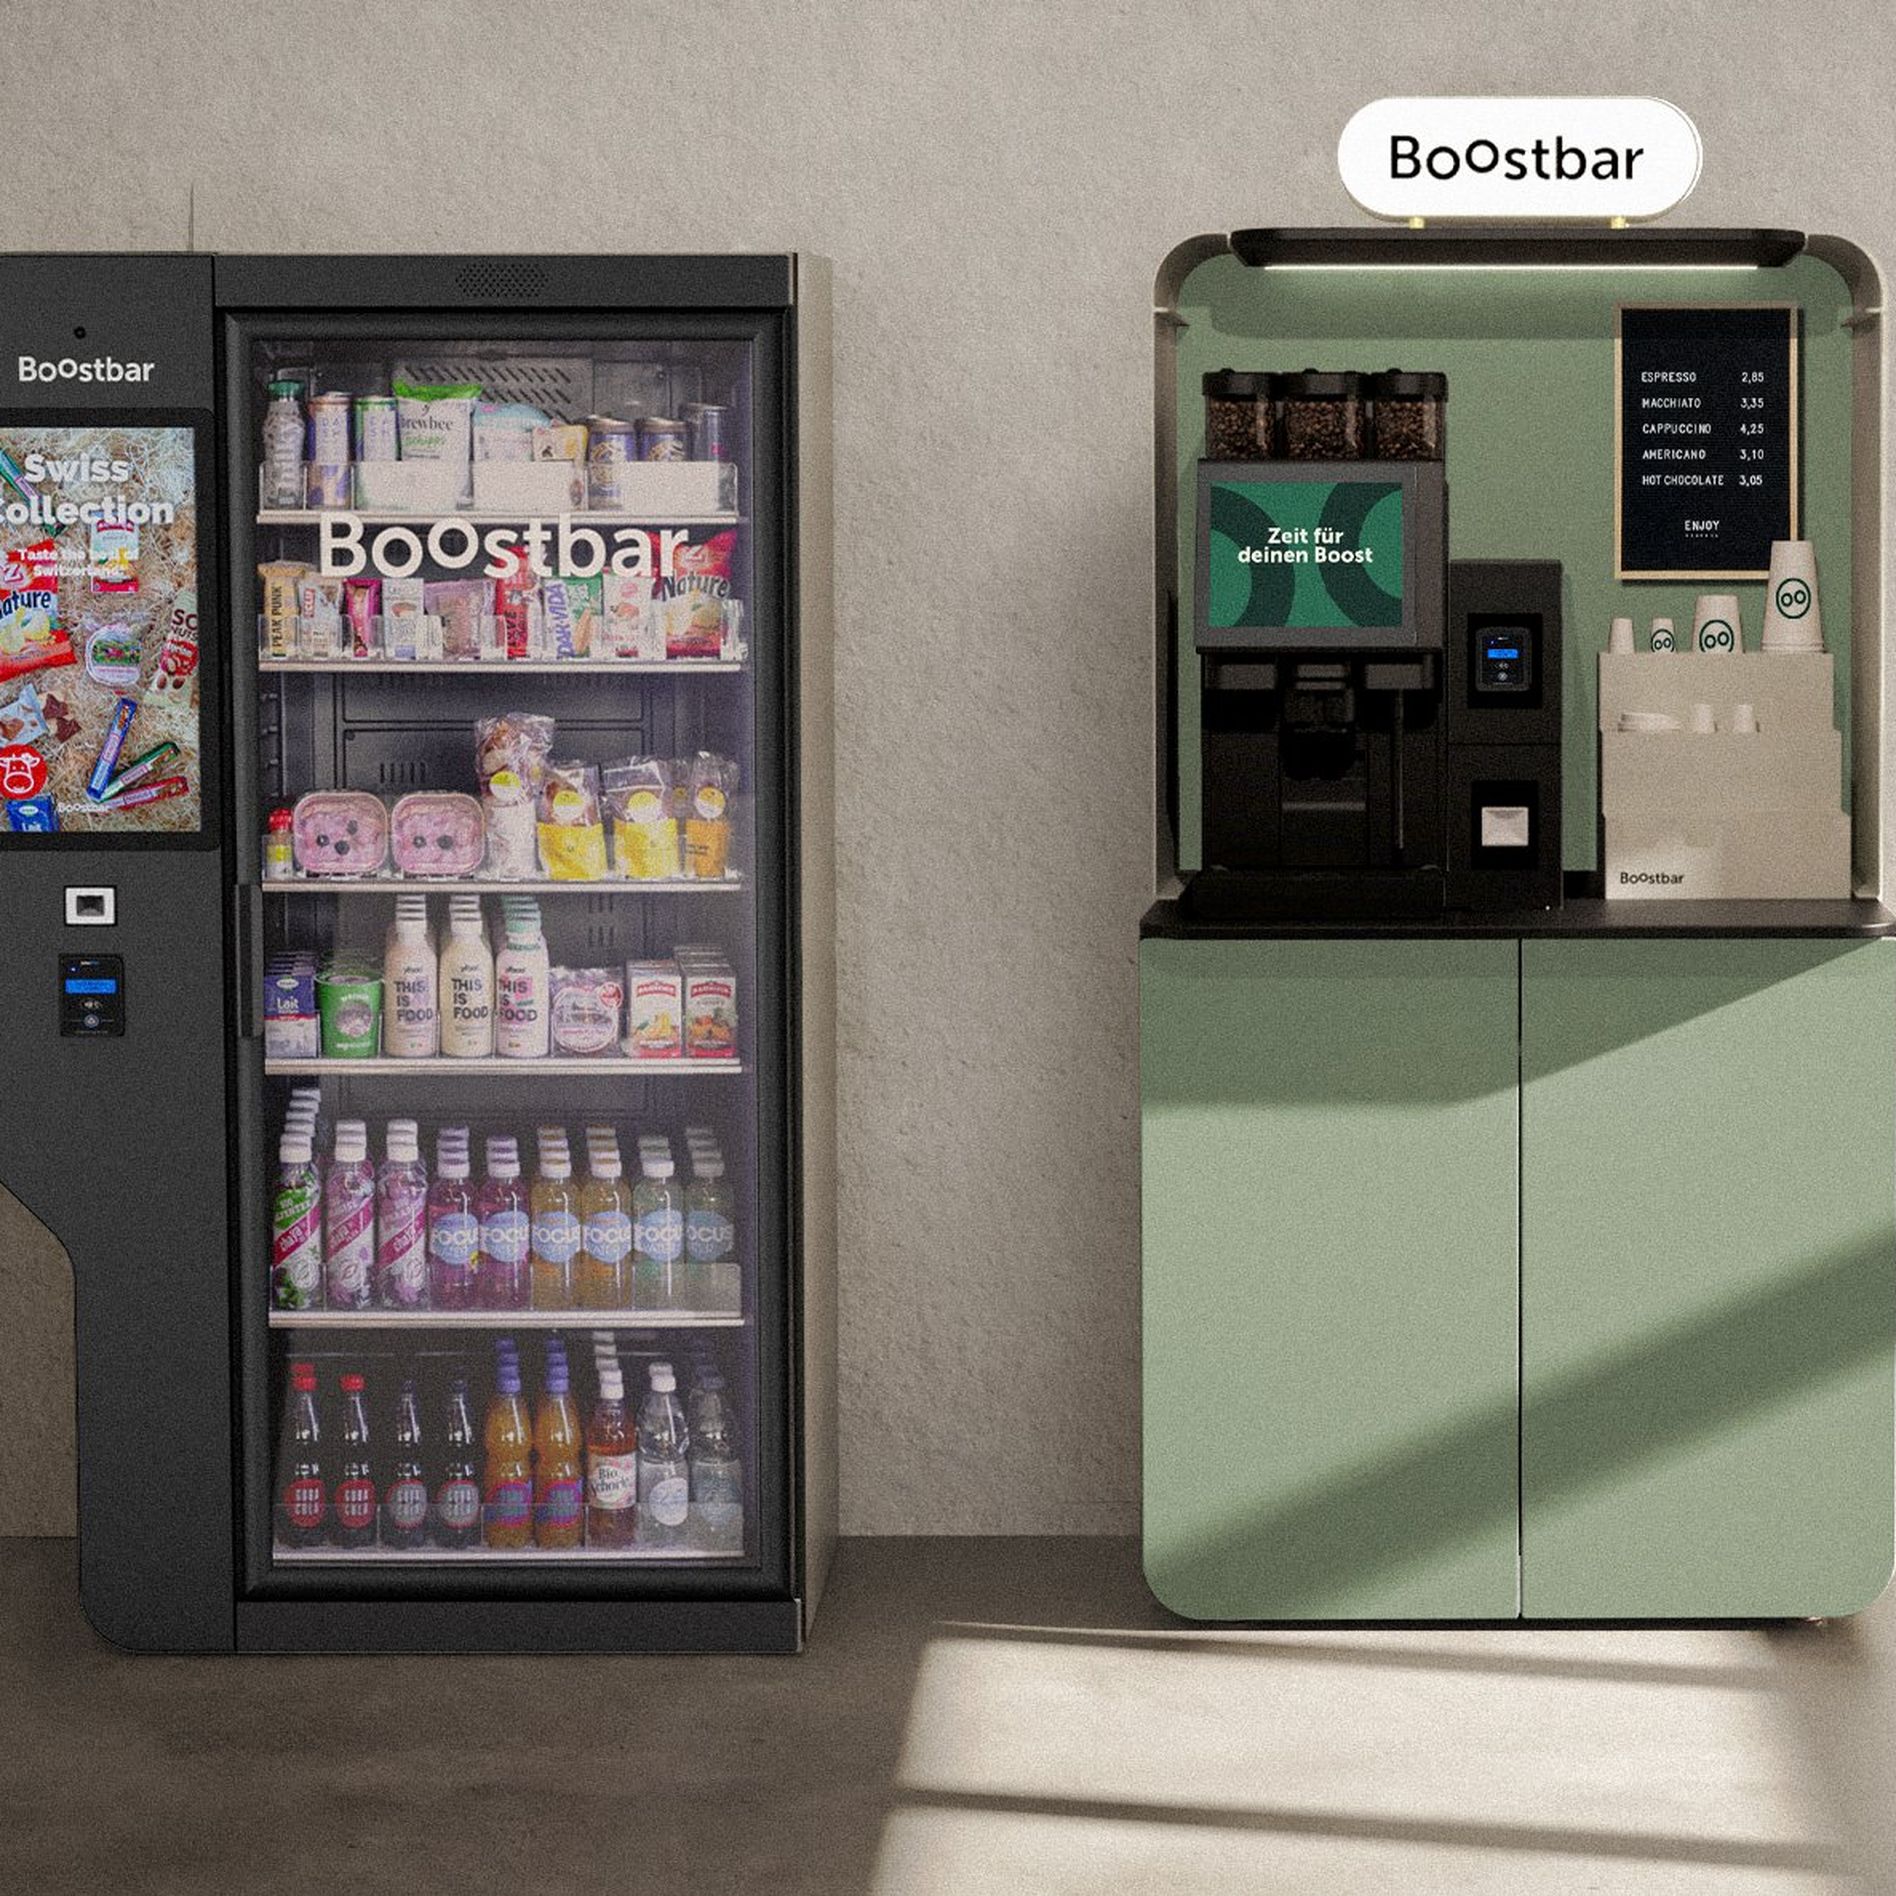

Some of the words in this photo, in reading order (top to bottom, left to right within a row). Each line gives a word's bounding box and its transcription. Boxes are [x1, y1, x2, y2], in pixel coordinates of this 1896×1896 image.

[1390, 135, 1644, 181] Boostbar
[18, 356, 155, 383] Boostbar
[1641, 371, 1697, 383] ESPRESSO
[1741, 371, 1765, 384] 2,85
[1641, 397, 1702, 409] MACCHIATO
[1740, 397, 1764, 410] 3,35
[1642, 422, 1712, 435] CAPPUCCINO
[1740, 423, 1765, 436] 4,25
[1642, 448, 1707, 460] AMERICANO
[1739, 448, 1764, 461] 3,10
[24, 453, 130, 483] Swiss
[1641, 474, 1662, 486] HOT
[1663, 474, 1724, 486] CHOCOLATE
[1739, 474, 1763, 487] 3,05
[0, 496, 174, 525] ollection
[1684, 519, 1720, 531] ENJOY
[1267, 527, 1309, 544] Zeit
[1313, 527, 1344, 544] für
[321, 511, 689, 579] Boostbar
[1237, 546, 1309, 564] deinen
[1314, 546, 1374, 564] Boost
[660, 570, 731, 602] Nature
[0, 590, 51, 619] ature
[271, 586, 283, 616] PUNK
[271, 619, 283, 648] PEAK
[1620, 872, 1685, 885] Boostbar
[452, 978, 482, 992] THIS
[276, 996, 299, 1009] Lait
[396, 995, 410, 1008] IS
[454, 992, 467, 1005] IS
[397, 1008, 433, 1021] FOOD
[454, 1006, 488, 1020] FOOD
